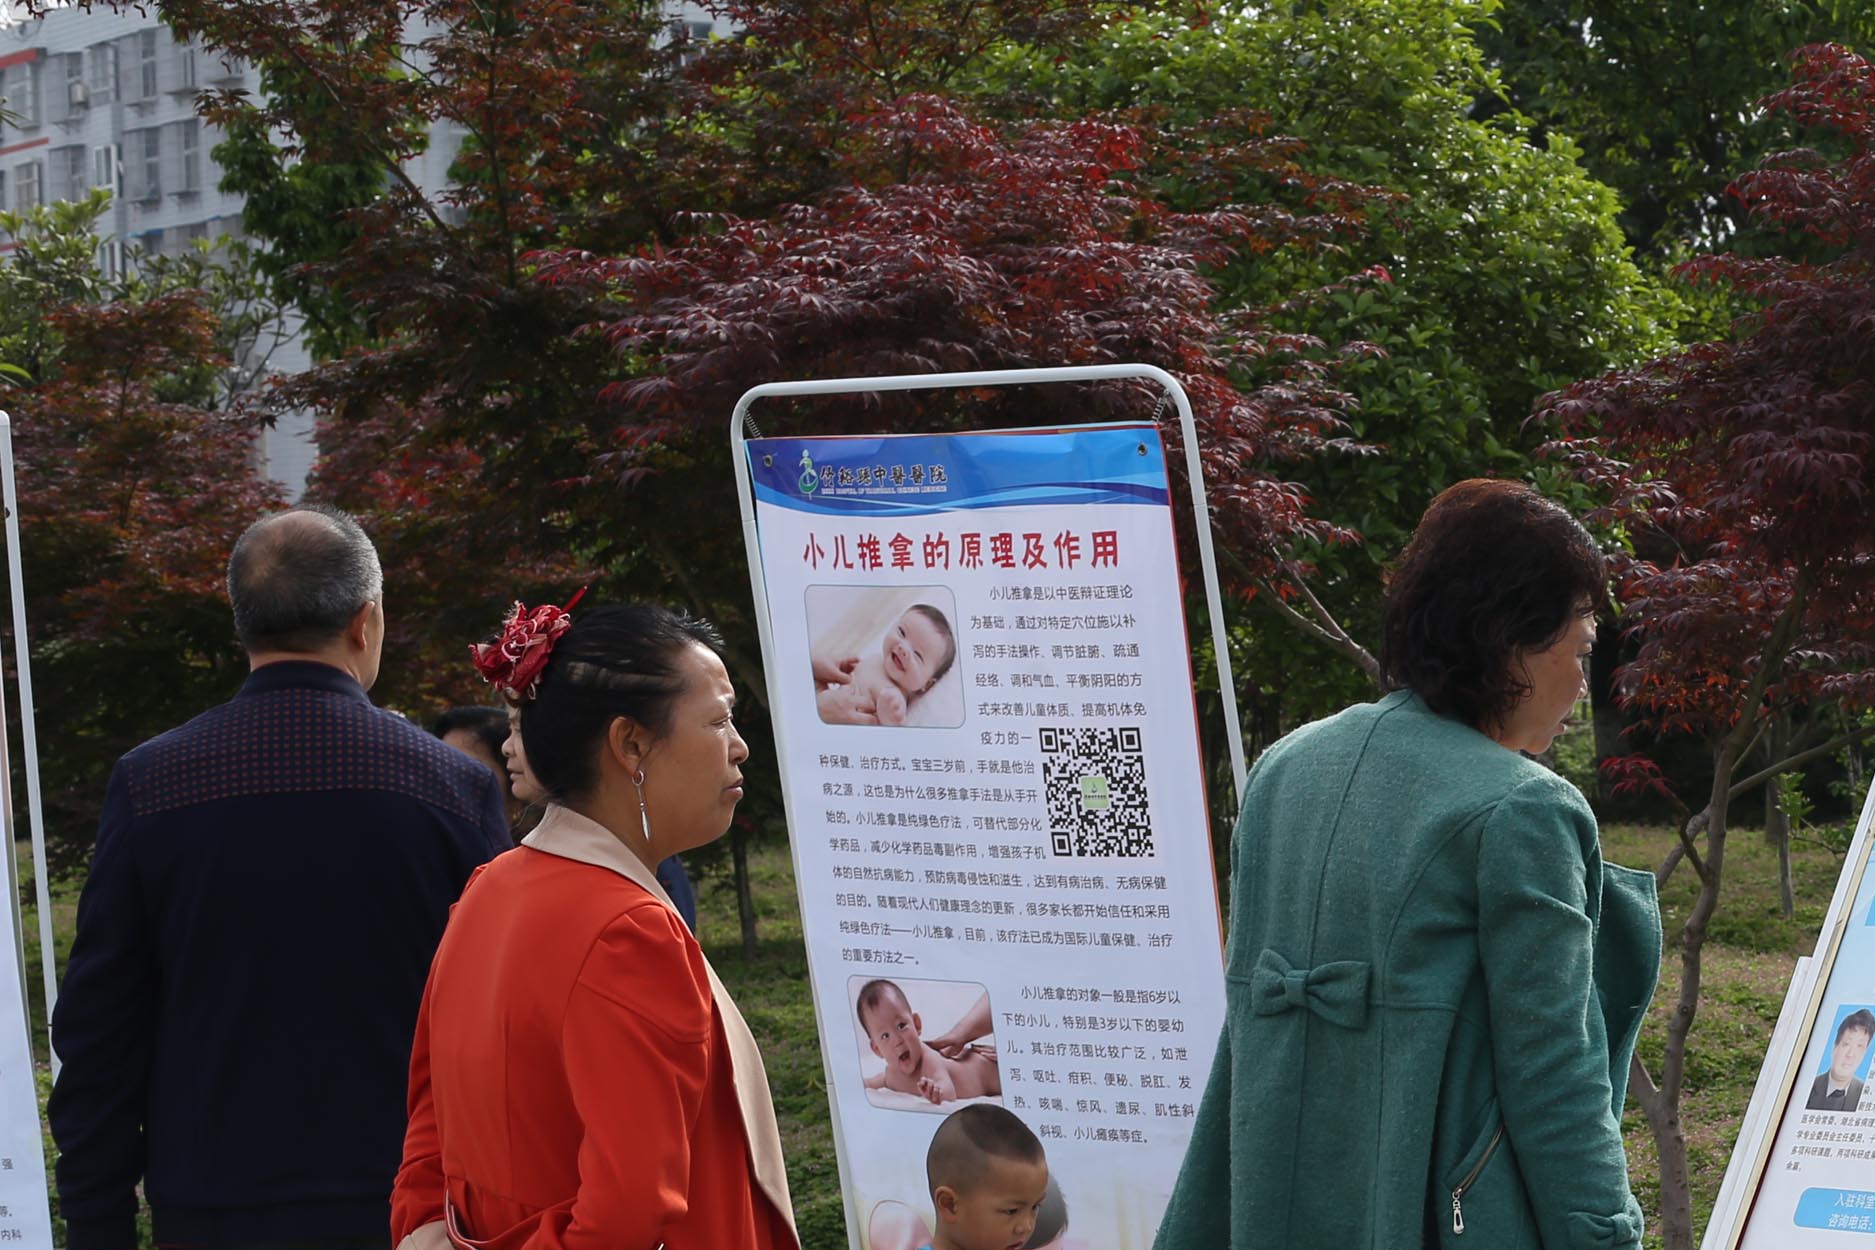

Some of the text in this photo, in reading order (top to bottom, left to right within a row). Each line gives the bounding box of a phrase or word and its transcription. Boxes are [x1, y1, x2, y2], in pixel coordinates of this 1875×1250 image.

[803, 529, 1119, 571] 小儿推拿的原理及作用
